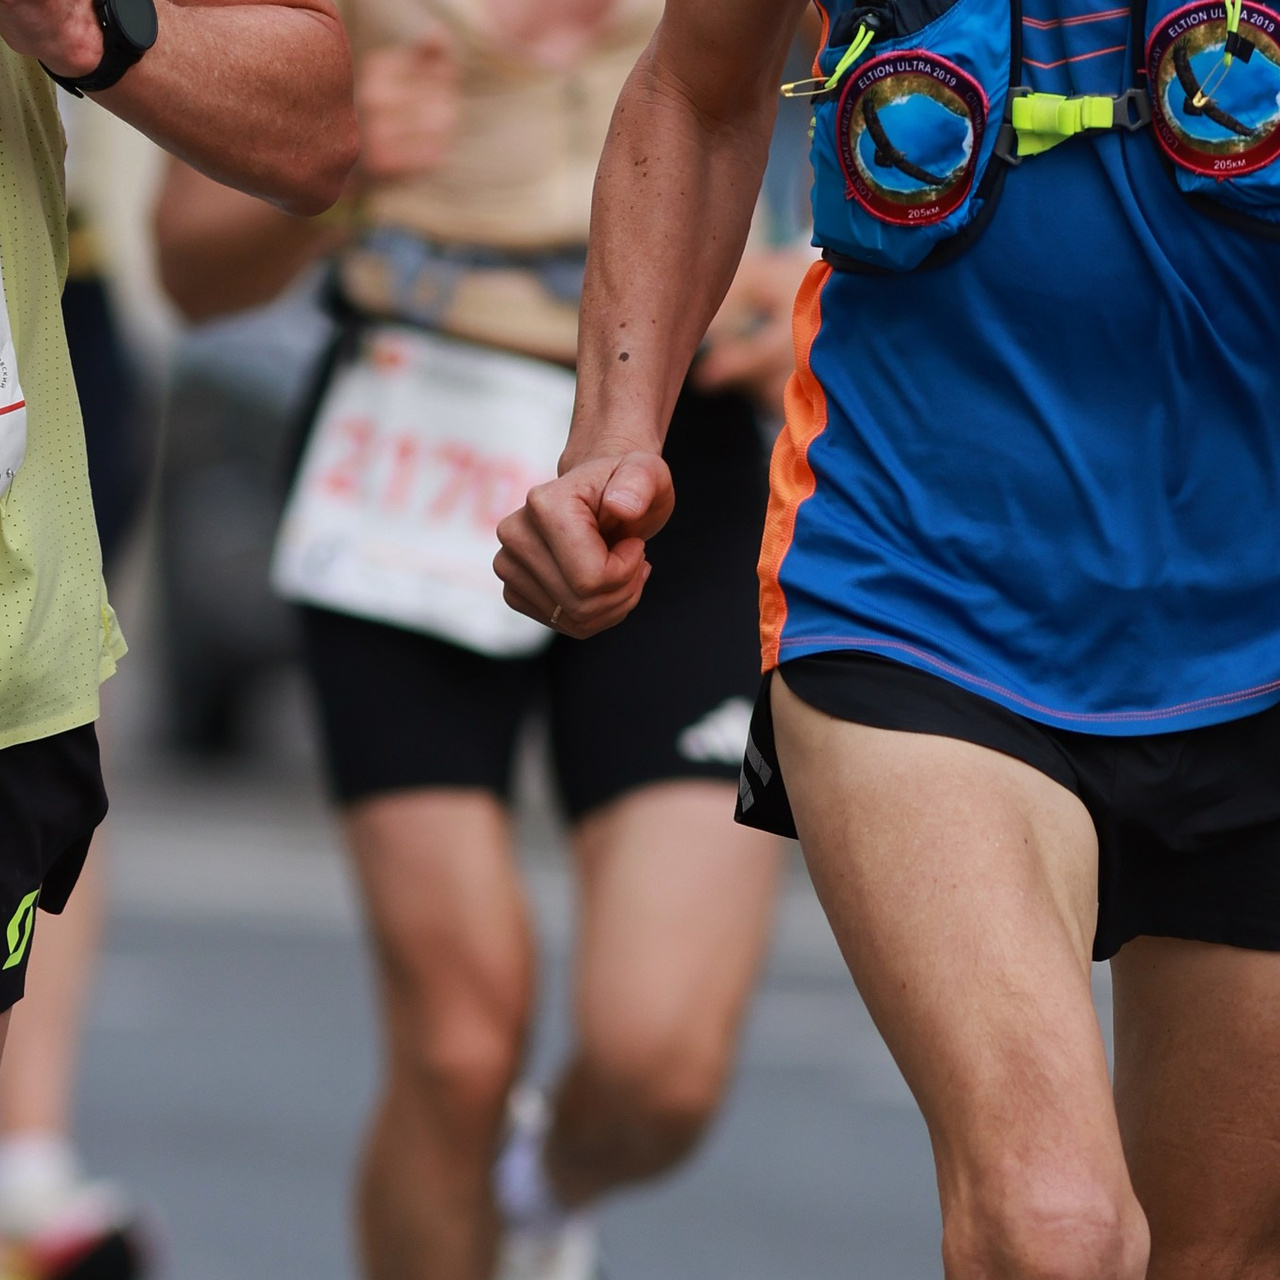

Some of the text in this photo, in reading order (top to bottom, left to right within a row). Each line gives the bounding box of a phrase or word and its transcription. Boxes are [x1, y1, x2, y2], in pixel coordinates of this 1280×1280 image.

[1168, 9, 1276, 39] ELTION ULA 2019
[858, 61, 957, 90] ELTION ULTRA 2019
